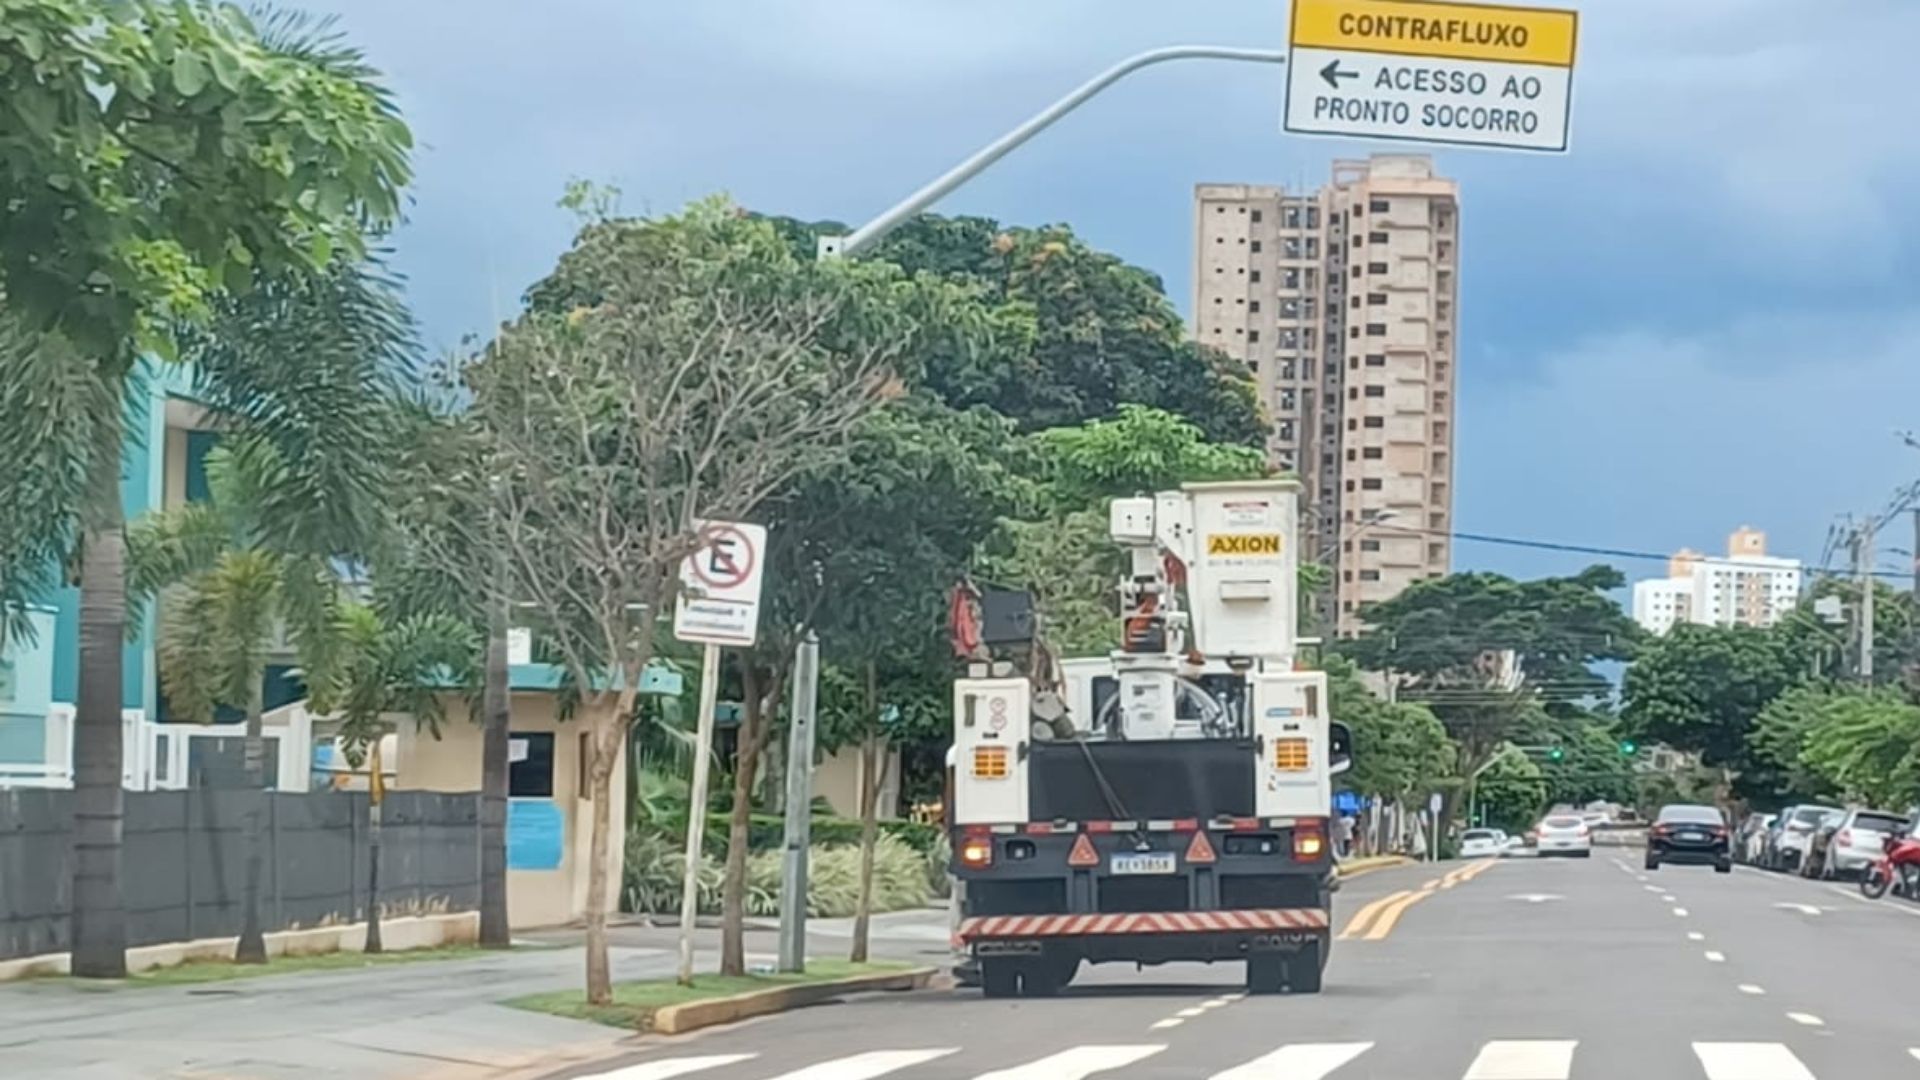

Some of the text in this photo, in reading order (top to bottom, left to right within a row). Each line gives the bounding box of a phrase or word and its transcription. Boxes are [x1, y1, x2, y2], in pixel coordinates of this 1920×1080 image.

[1339, 13, 1528, 48] CONTRAFLUXO
[1374, 67, 1541, 100] ACESSO AO
[1314, 96, 1538, 134] PRONTO SOCORRO
[709, 538, 738, 575] E
[1209, 535, 1279, 553] AXION
